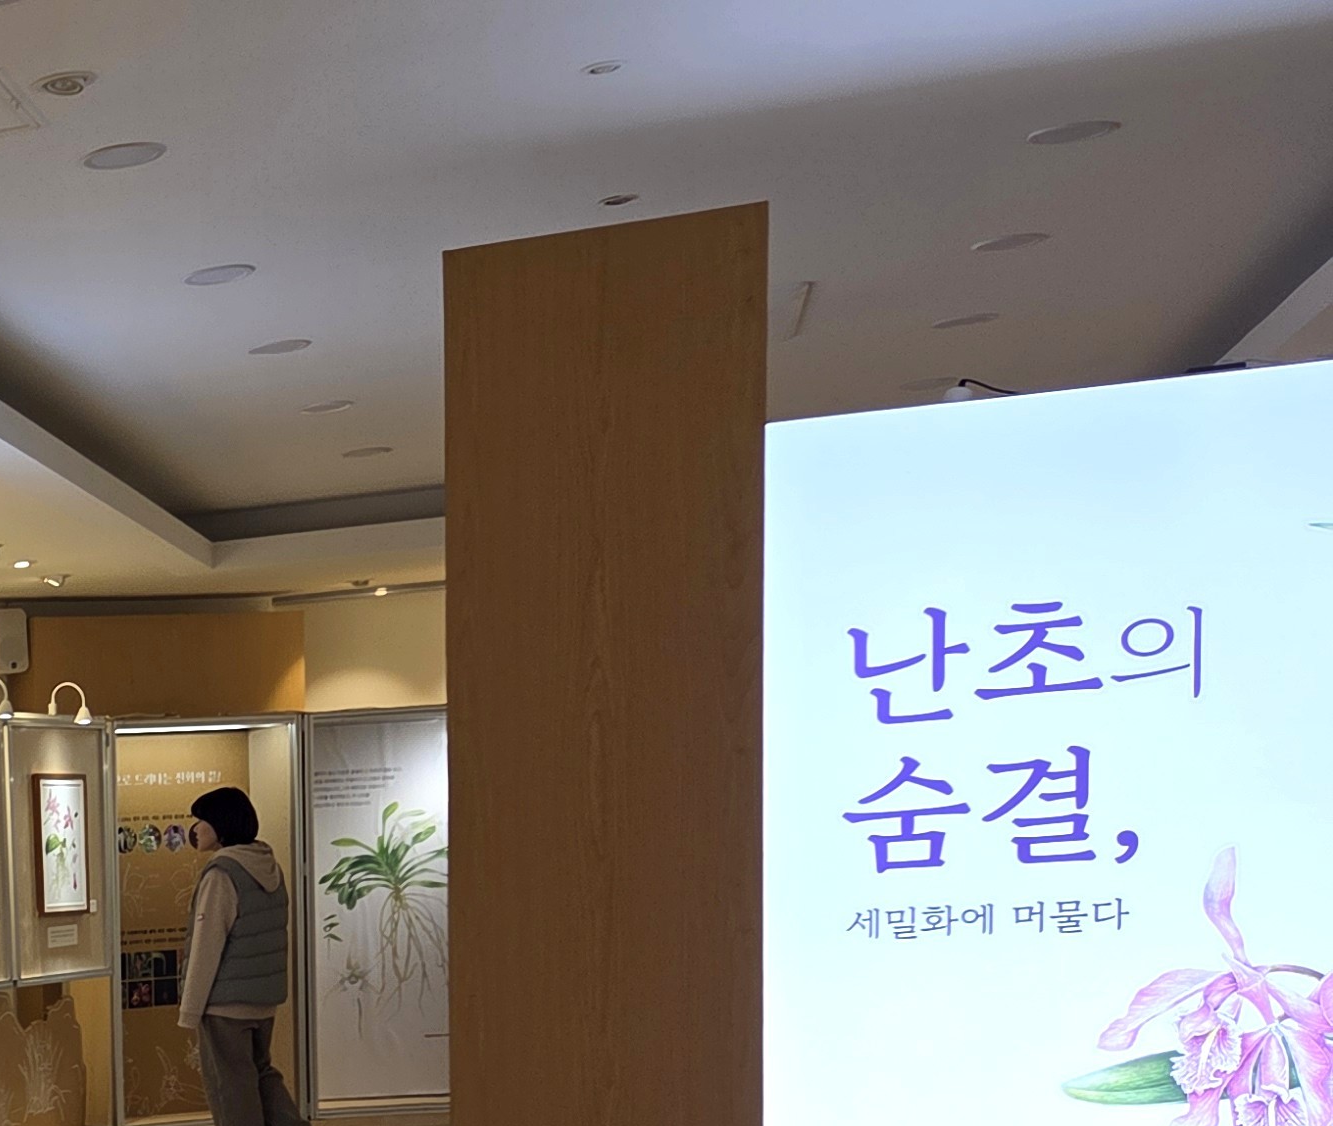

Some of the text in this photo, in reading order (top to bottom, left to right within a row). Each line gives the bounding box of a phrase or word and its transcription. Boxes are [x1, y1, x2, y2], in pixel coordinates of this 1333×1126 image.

[846, 600, 1203, 725] 난초의
[842, 745, 1140, 873] 숨결,
[846, 897, 1131, 940] 세밀화에 머물다
